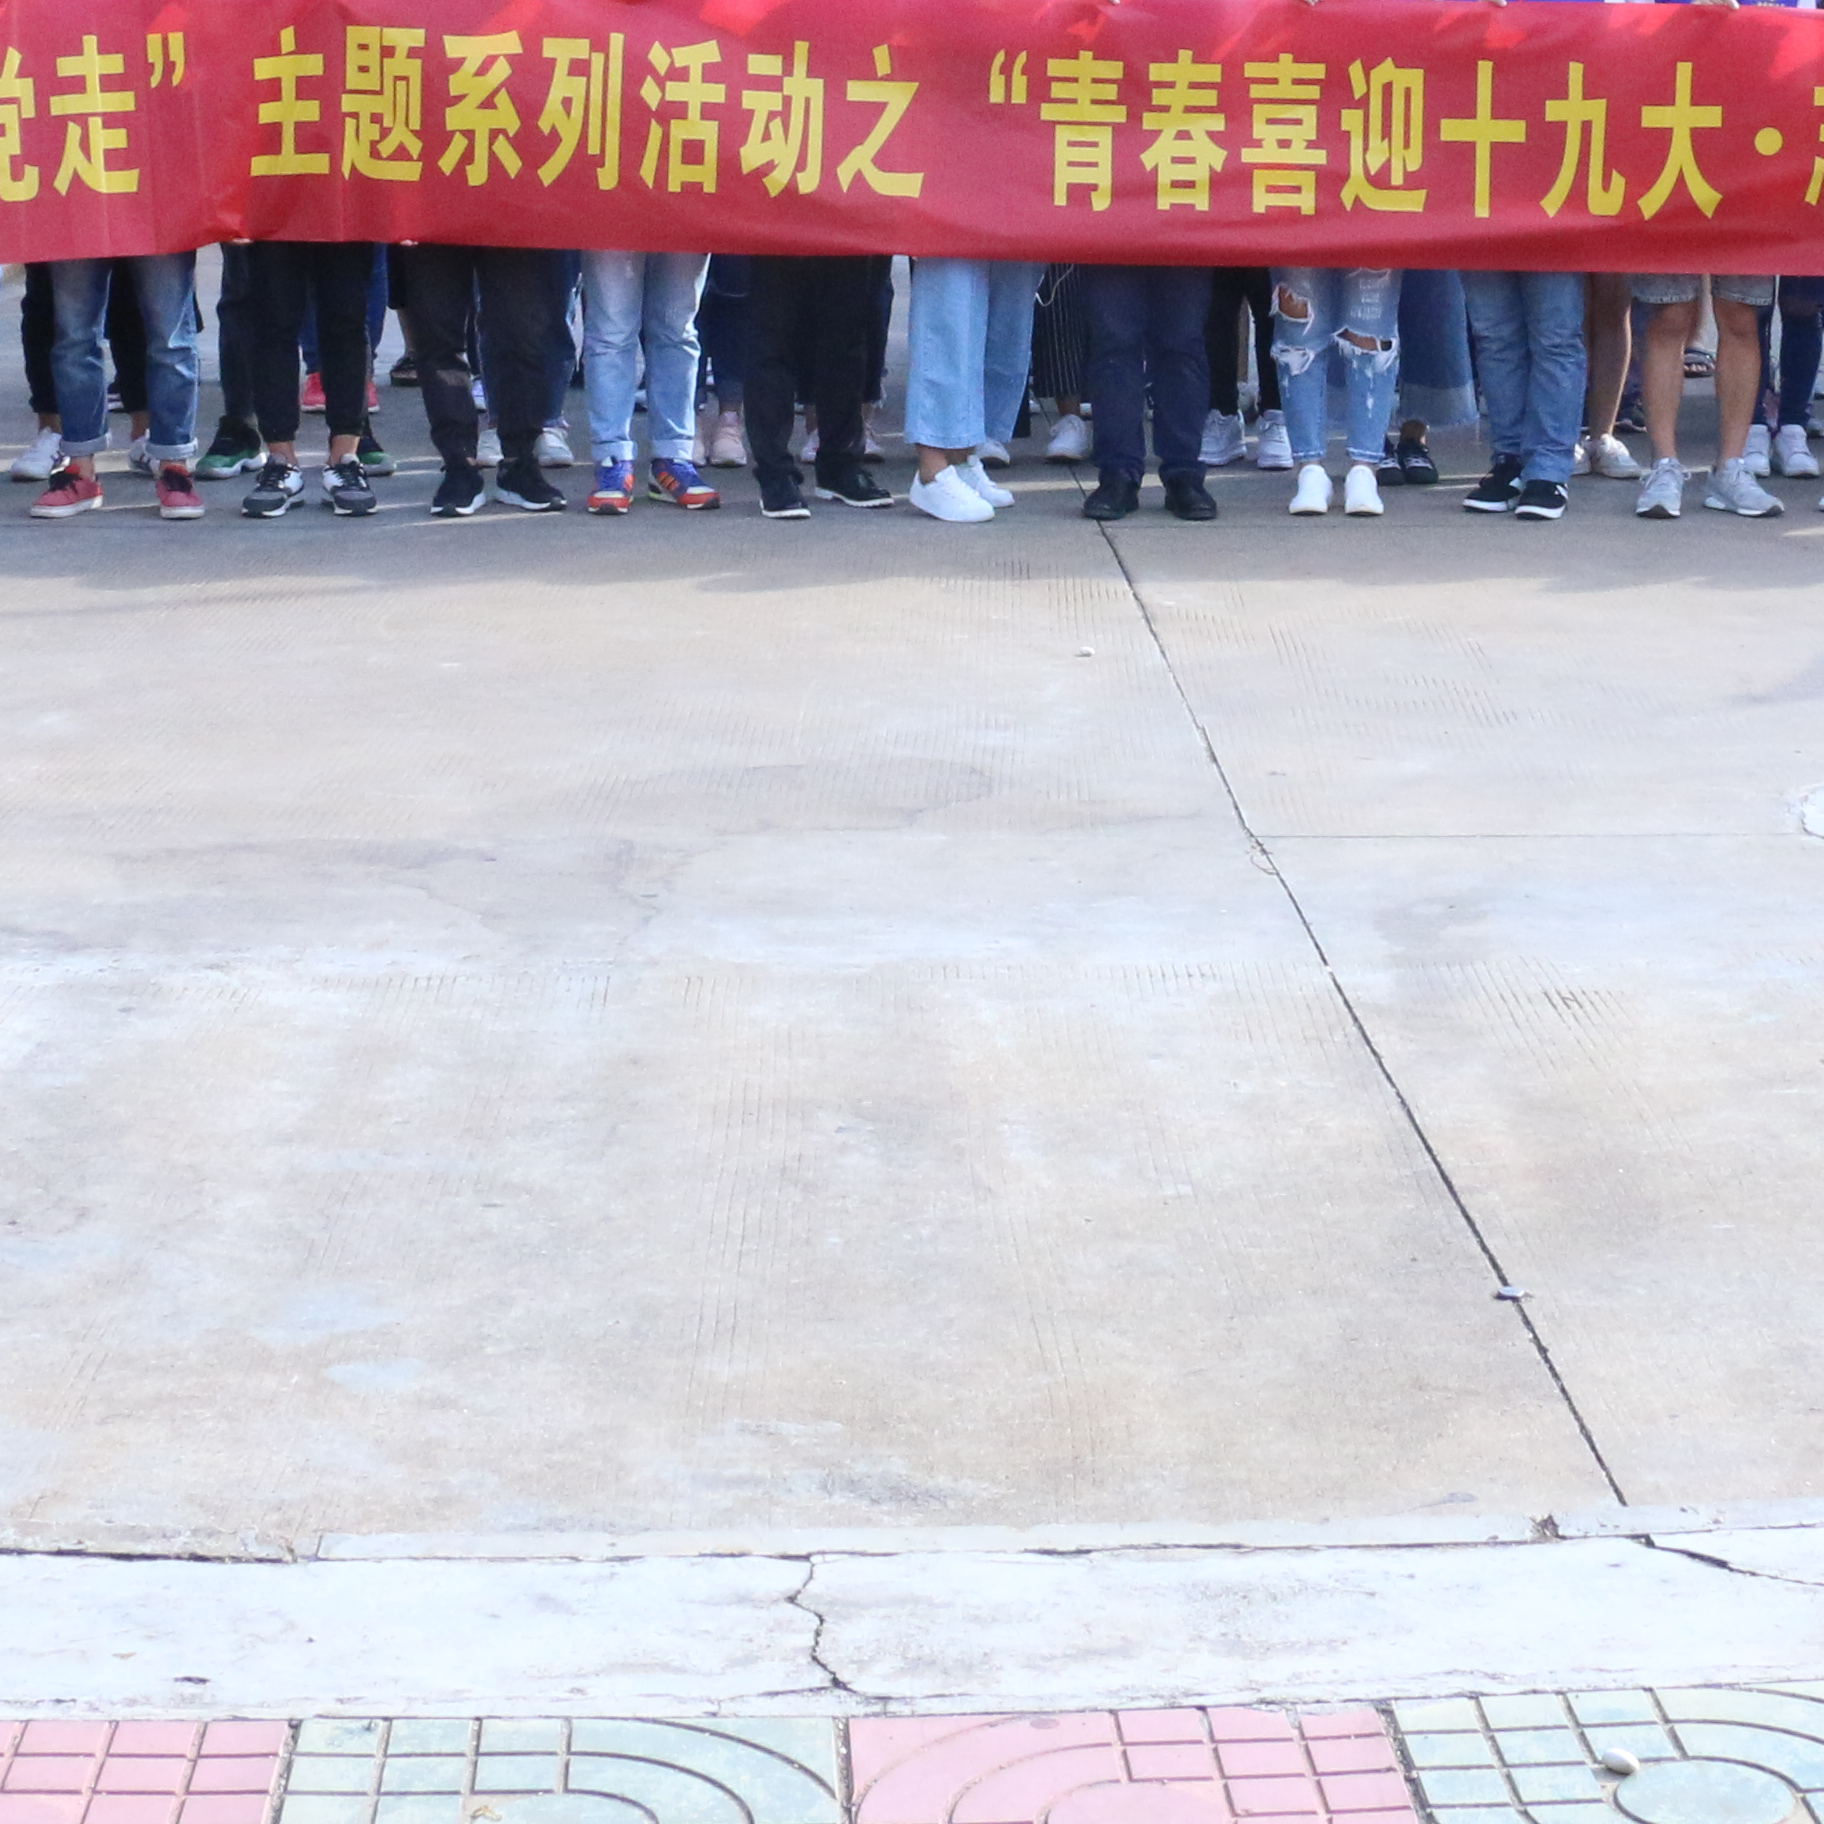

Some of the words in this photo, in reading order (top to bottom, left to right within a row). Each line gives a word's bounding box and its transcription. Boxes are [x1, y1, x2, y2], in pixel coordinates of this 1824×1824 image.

[250, 25, 924, 198] 主题系列活动之
